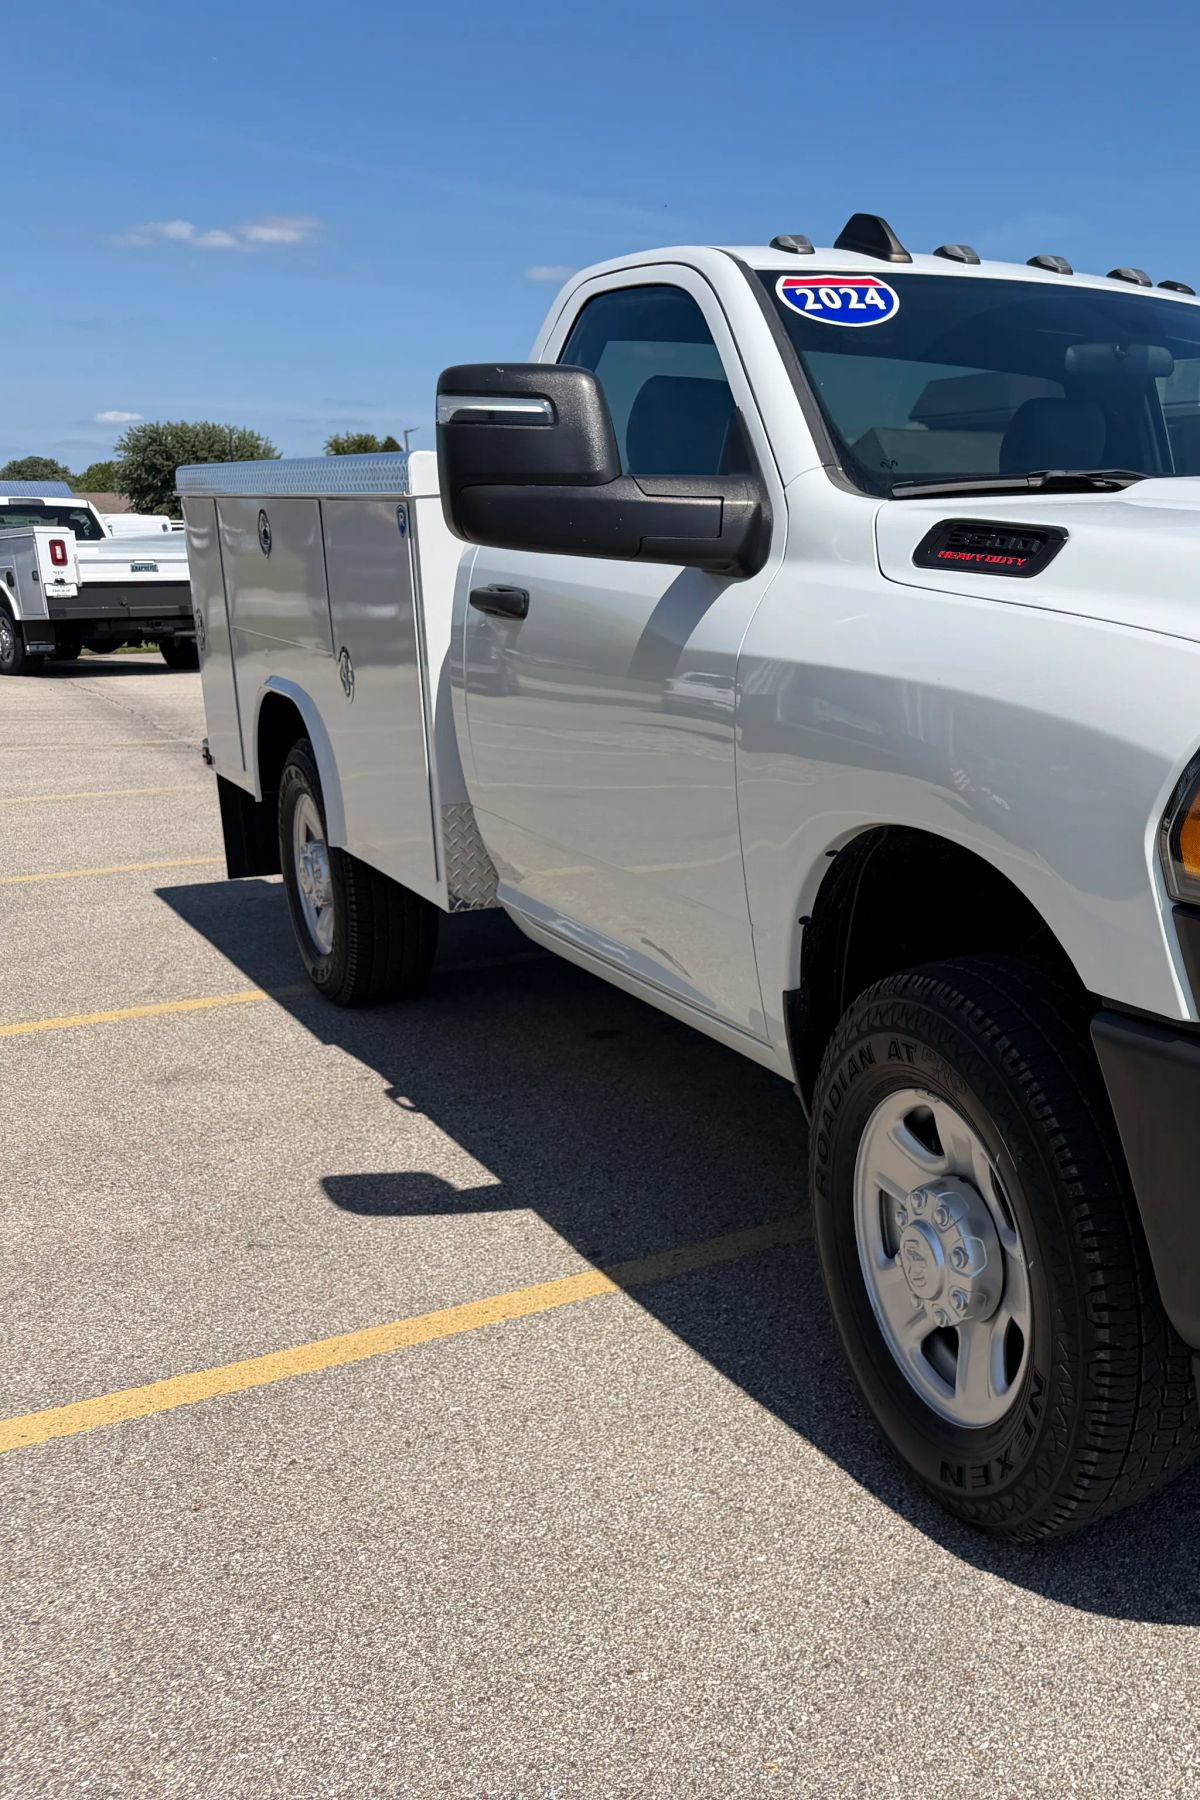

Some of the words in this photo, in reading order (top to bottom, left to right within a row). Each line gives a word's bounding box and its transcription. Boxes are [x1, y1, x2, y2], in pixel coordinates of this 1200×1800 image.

[795, 287, 887, 310] 2024
[815, 1044, 876, 1197] ROADIAN
[887, 1038, 918, 1063] AT
